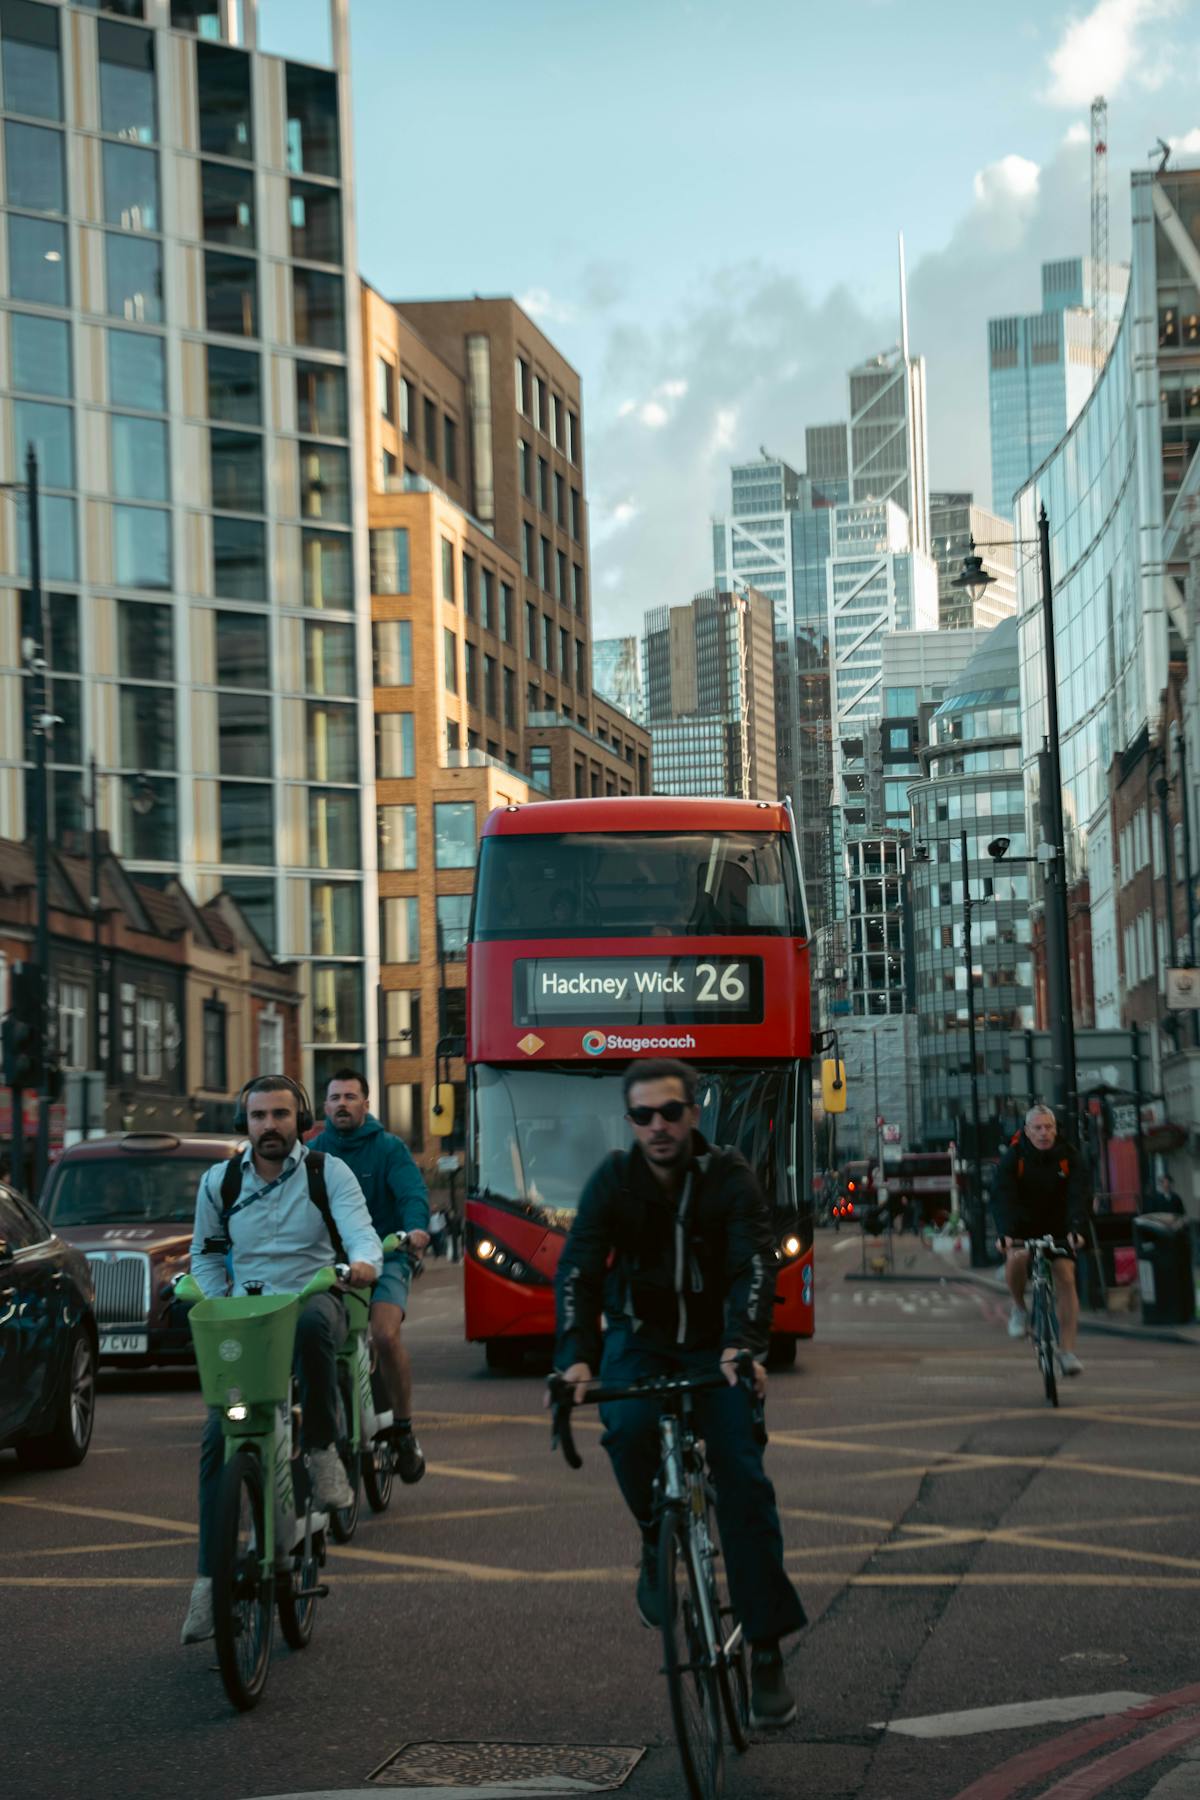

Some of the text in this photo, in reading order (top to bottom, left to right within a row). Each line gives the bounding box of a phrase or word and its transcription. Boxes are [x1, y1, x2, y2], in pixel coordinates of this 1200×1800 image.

[542, 963, 744, 1001] Hackney Wick 26
[607, 1034, 696, 1051] Stagecoach
[110, 1335, 139, 1350] CVU
